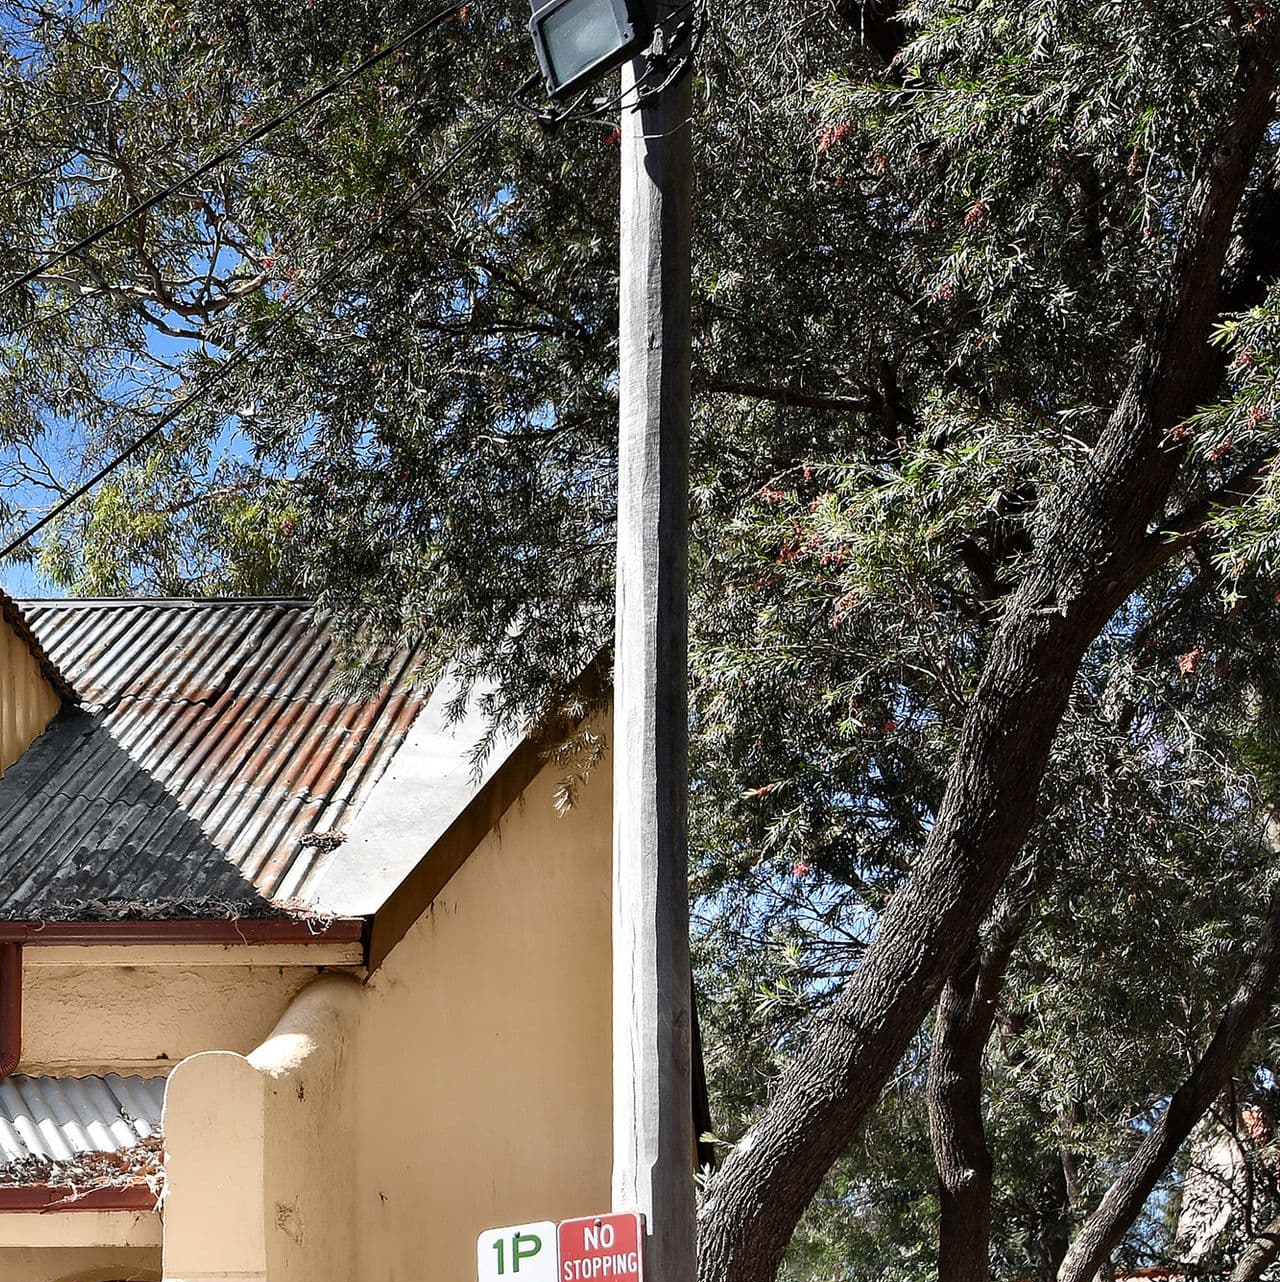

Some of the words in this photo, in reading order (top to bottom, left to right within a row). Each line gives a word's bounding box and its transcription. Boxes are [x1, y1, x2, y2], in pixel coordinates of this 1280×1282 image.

[583, 1223, 615, 1251] NO
[492, 1234, 542, 1275] 1P
[563, 1252, 638, 1281] STOPPING
